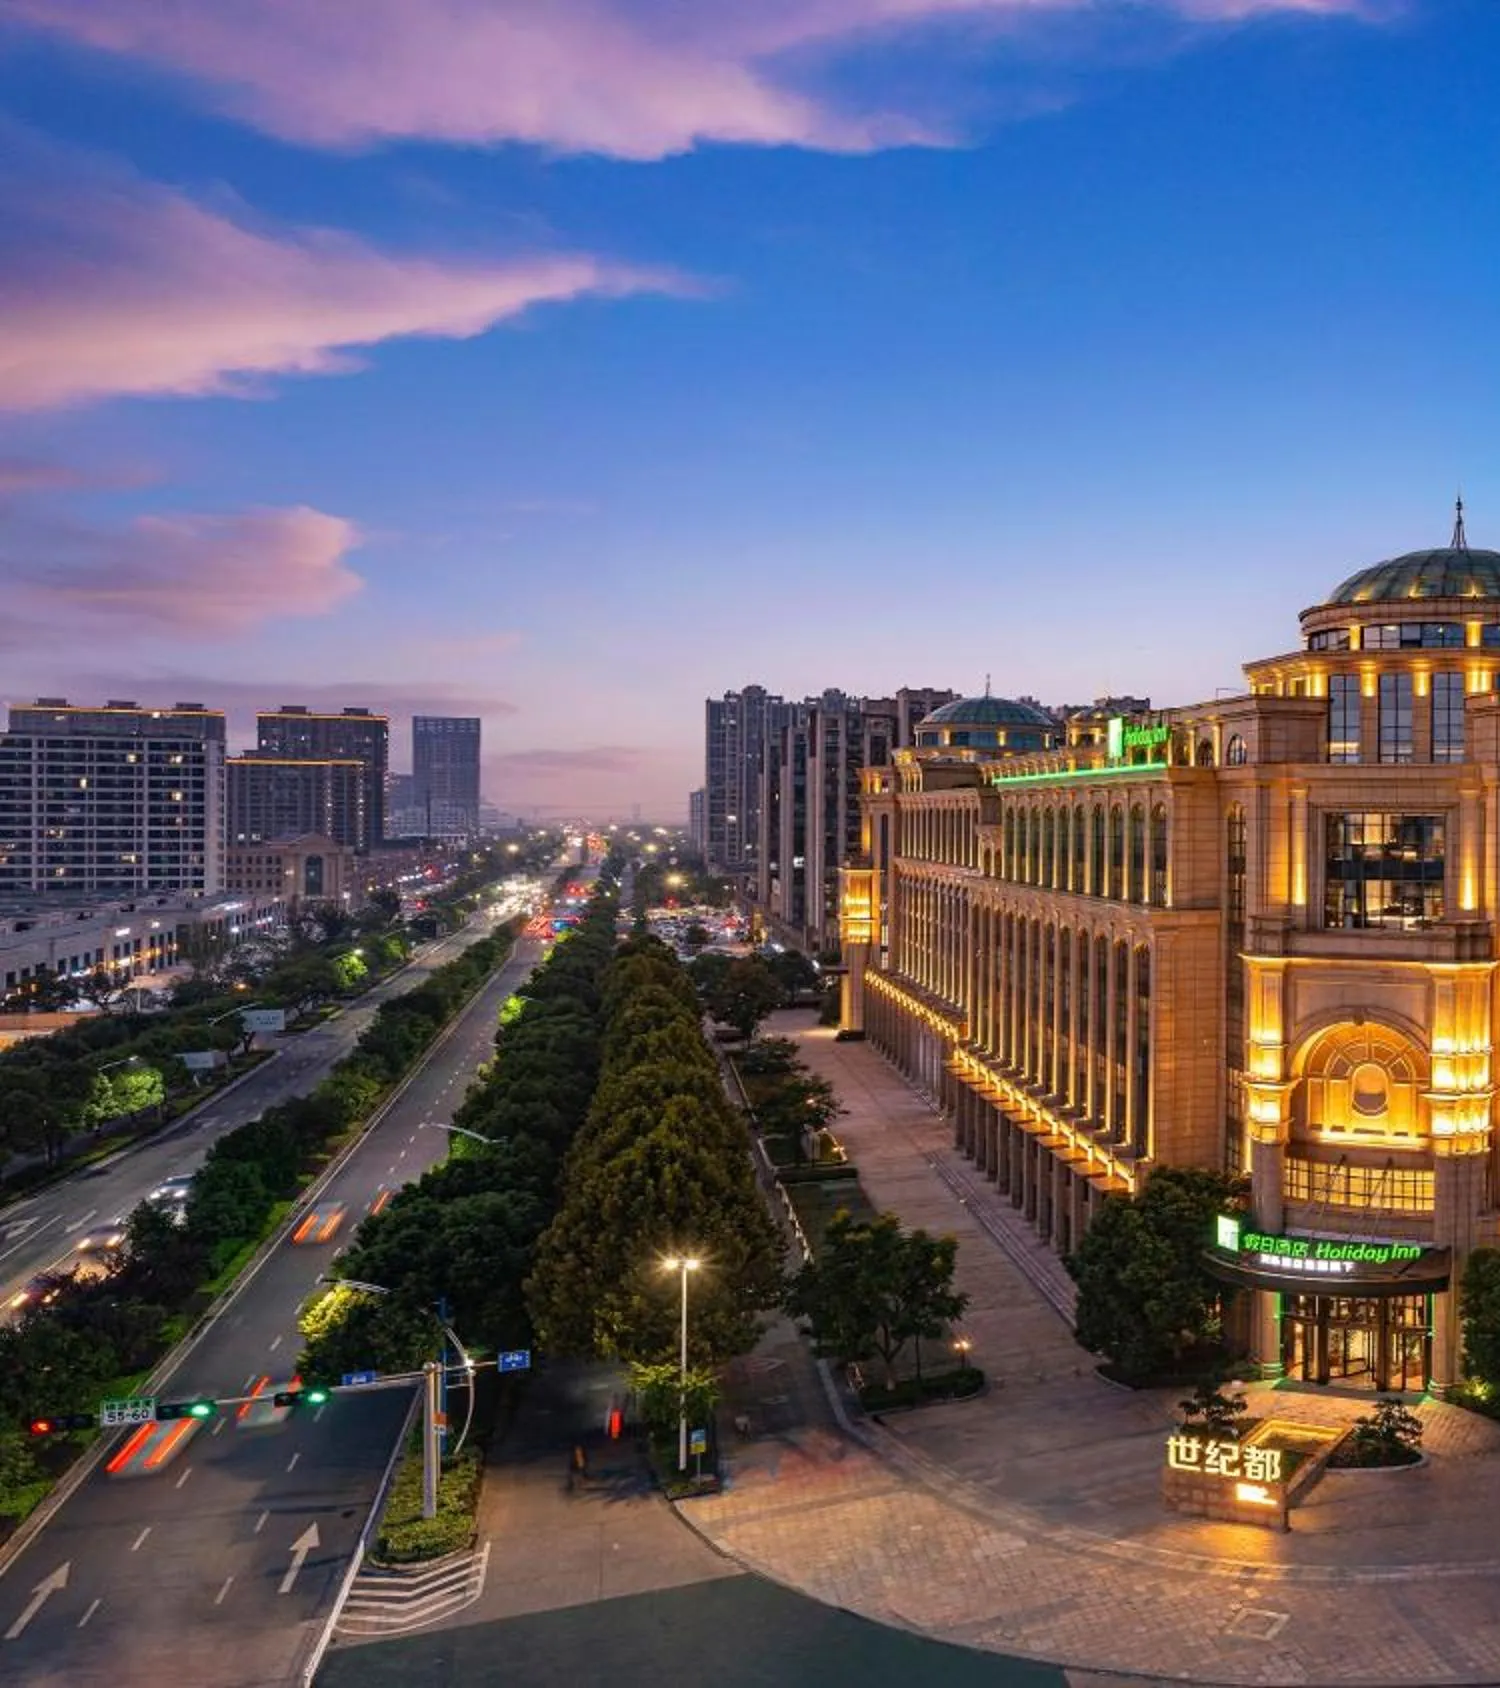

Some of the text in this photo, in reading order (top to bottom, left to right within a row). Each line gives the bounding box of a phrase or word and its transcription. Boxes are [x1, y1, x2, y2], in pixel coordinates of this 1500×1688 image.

[1315, 1241, 1389, 1264] Holiday
[1390, 1242, 1421, 1259] Inn
[1166, 1436, 1281, 1482] 世纪都
